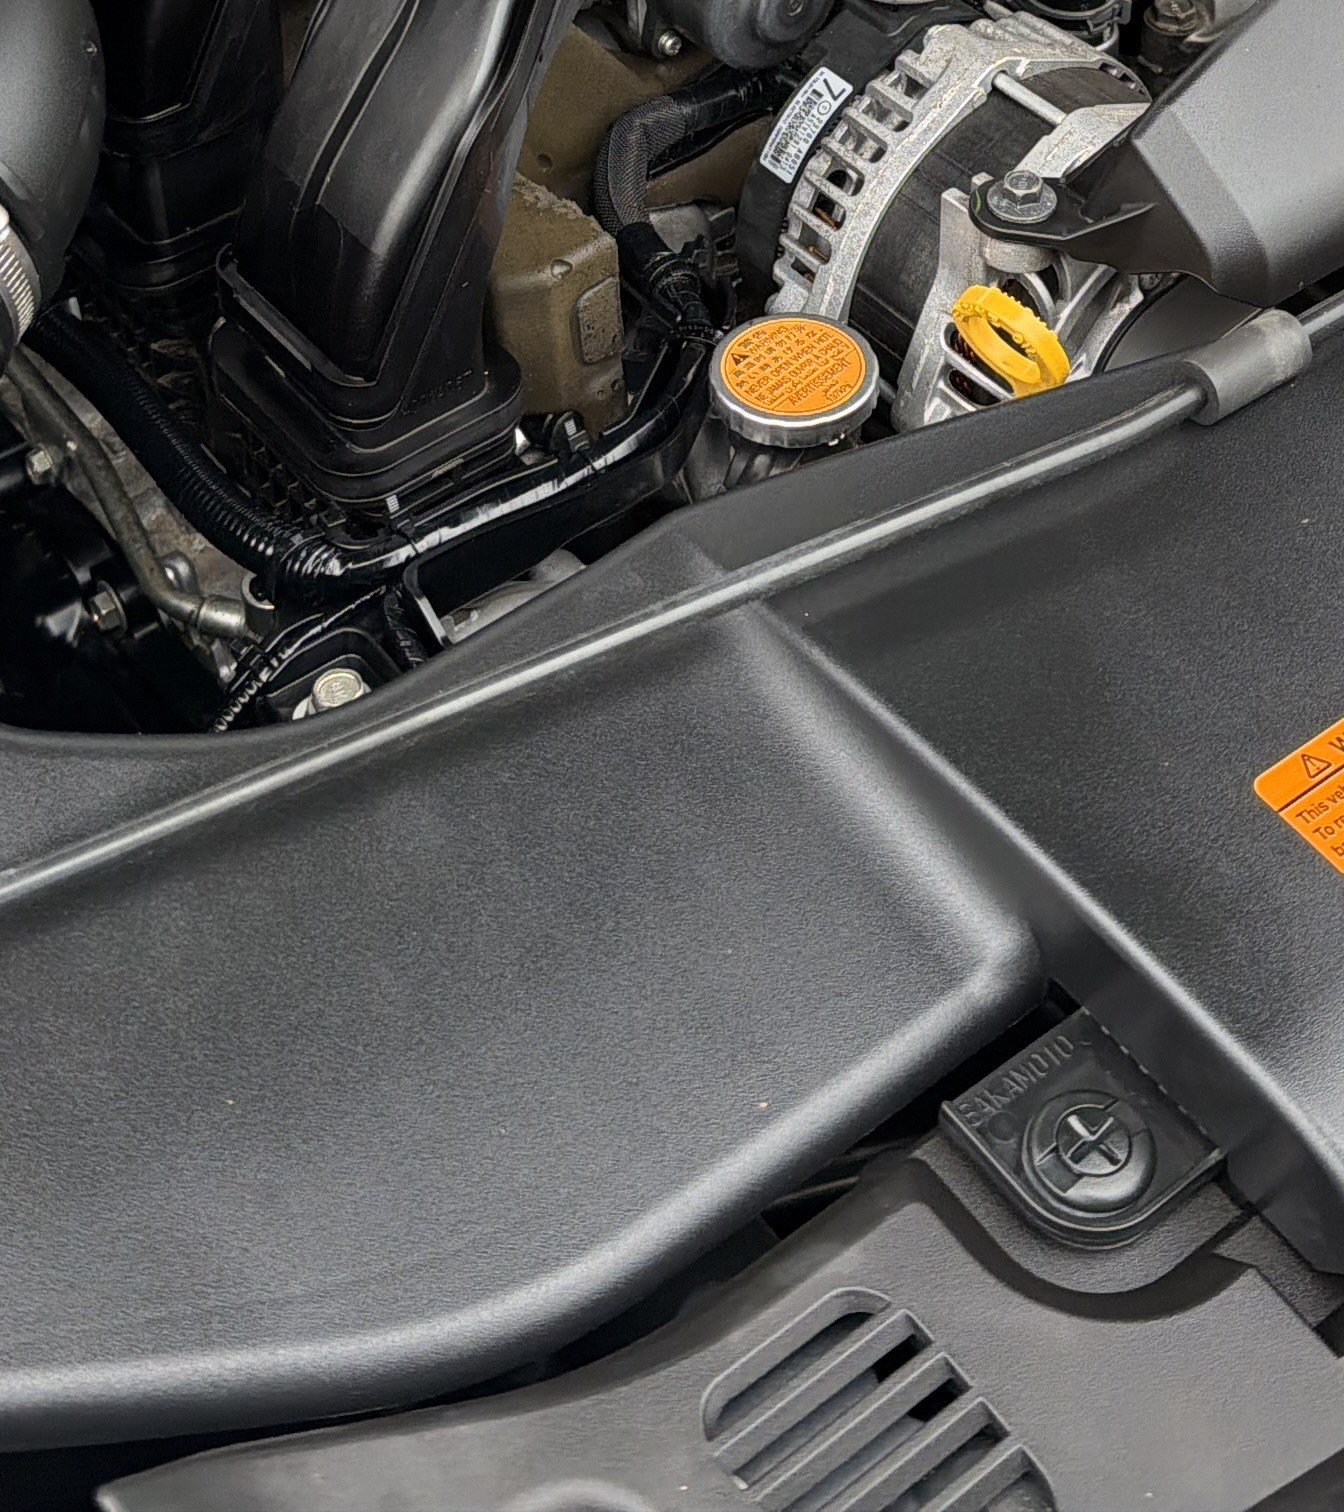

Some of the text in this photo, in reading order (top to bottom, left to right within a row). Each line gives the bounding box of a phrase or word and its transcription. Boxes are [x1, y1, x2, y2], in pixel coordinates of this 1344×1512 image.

[822, 77, 846, 102] 7
[1293, 800, 1330, 825] This
[1310, 824, 1336, 840] To
[958, 1034, 1075, 1128] SAKAMOTO
